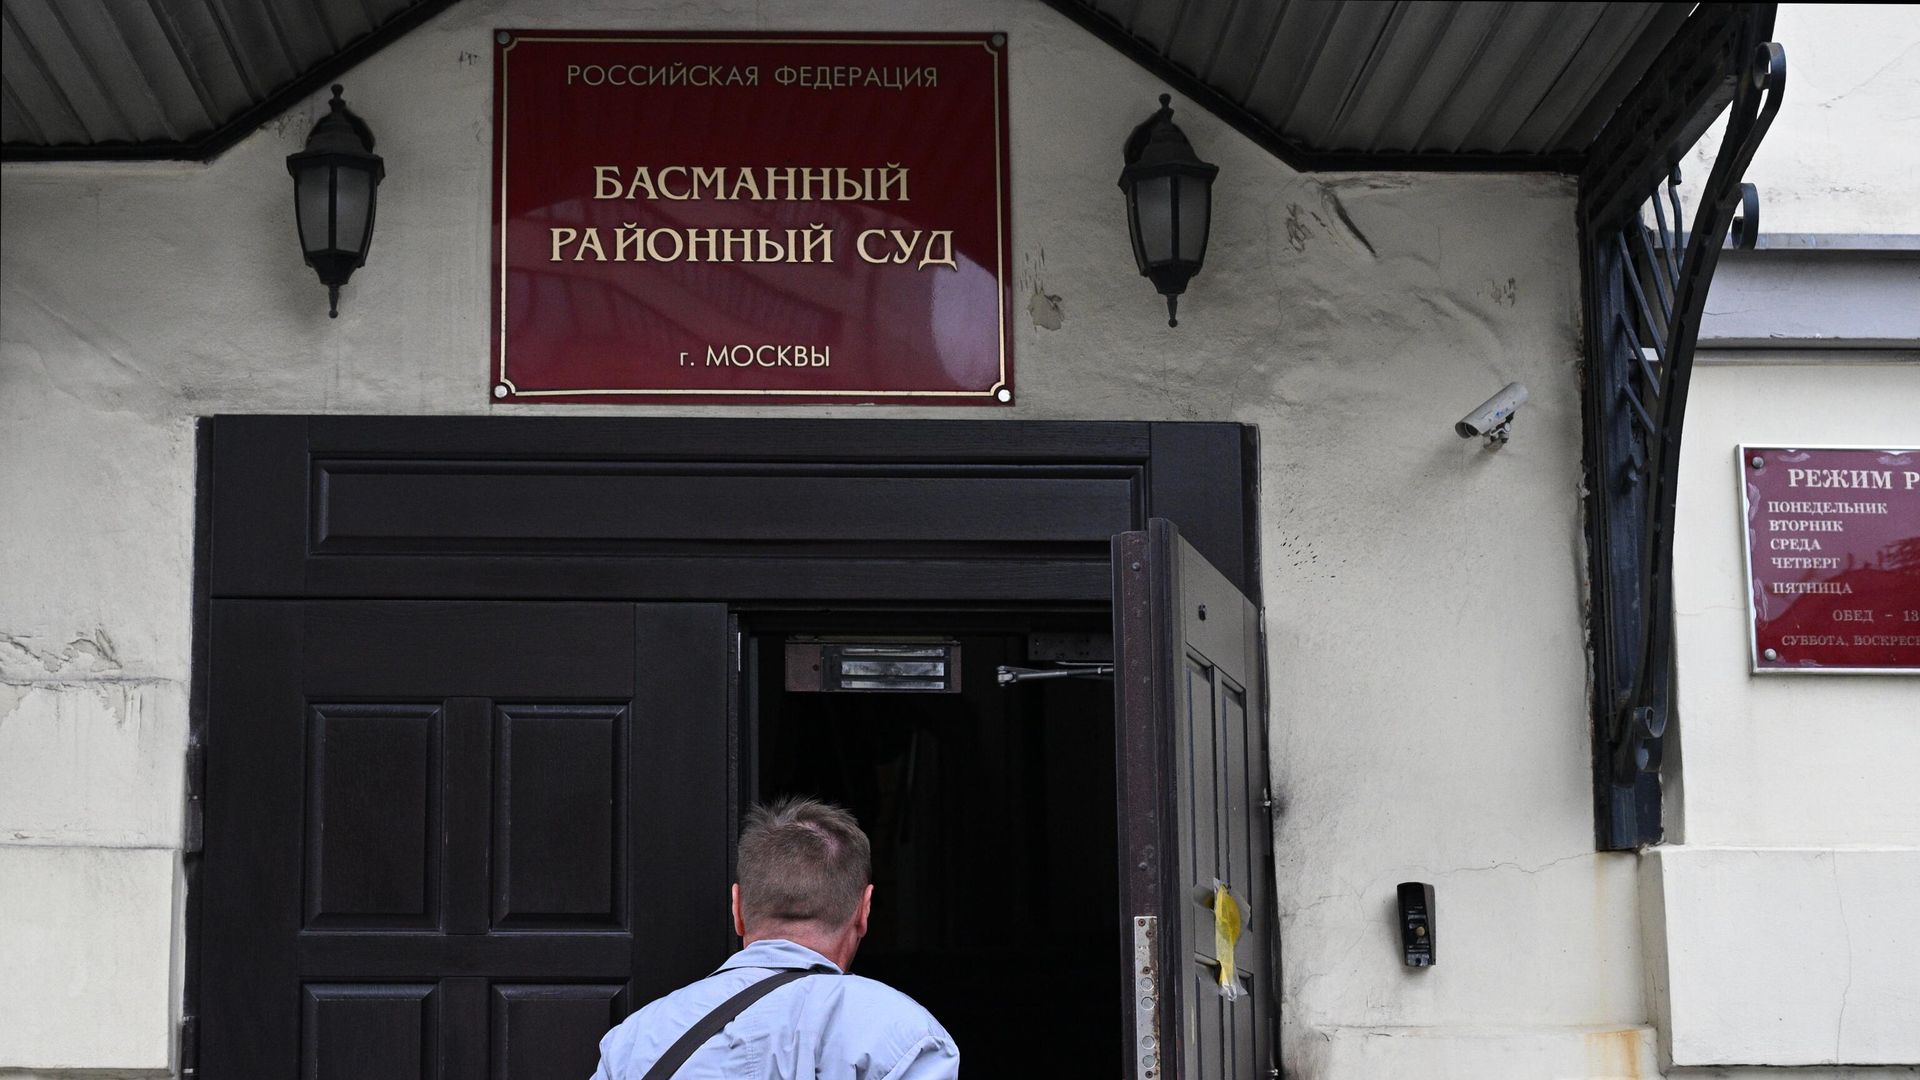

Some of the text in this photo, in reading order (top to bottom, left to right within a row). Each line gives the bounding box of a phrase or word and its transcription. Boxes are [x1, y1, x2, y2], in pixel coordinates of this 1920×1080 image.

[566, 63, 939, 90] РОССИЙСКАЯ ФЕДЕРАЦИЯ
[592, 162, 911, 202] БАСМАННЫЙ
[549, 222, 958, 272] РАЙОННЫЙ СУД
[679, 344, 831, 369] г. МОСКВЫ
[1787, 468, 1893, 490] РЕЖИМ
[1768, 500, 1888, 515] ПОНЕДЕЛЬНИК
[1769, 520, 1844, 532] ВТОРНИК
[1770, 538, 1822, 551] СРЕДА
[1771, 557, 1840, 569] ЧЕТВЕРГ
[1773, 582, 1853, 595] ПЯТНИЦА
[1832, 609, 1874, 623] ОБЕД
